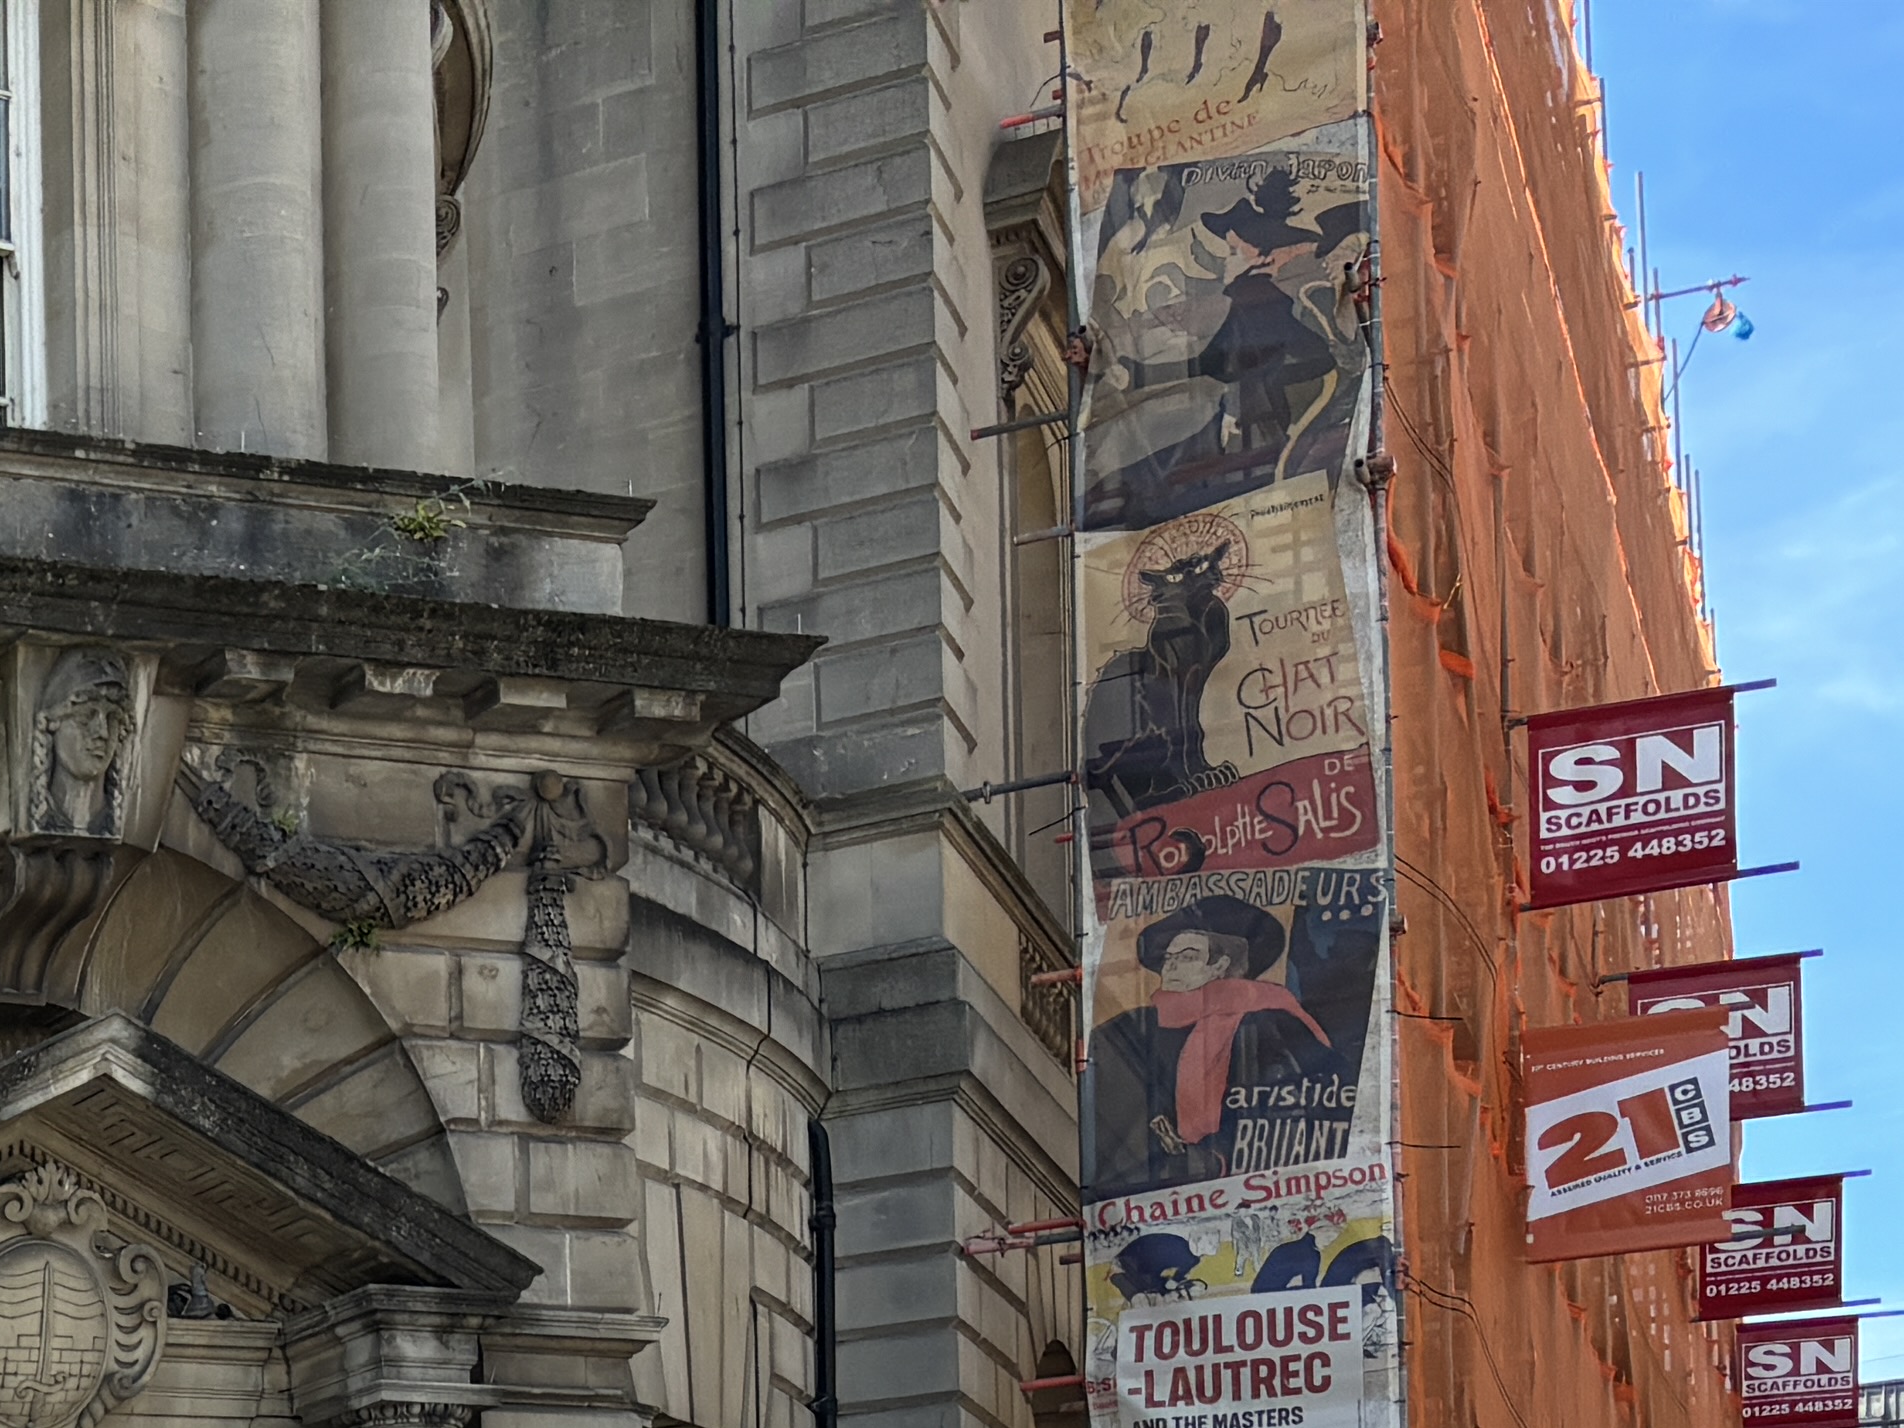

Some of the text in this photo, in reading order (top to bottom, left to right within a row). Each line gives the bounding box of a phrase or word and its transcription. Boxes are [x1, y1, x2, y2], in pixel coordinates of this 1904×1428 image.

[1193, 98, 1231, 125] de
[1236, 652, 1340, 715] CHAT
[1244, 695, 1366, 758] NOIR
[1324, 754, 1357, 776] DE
[1546, 725, 1721, 806] SN
[1545, 788, 1721, 834] SCAFFOLDS
[1540, 828, 1726, 875] 01225 448352
[1225, 1073, 1358, 1109] aristide
[1230, 1117, 1350, 1176] BRUANT
[1537, 1087, 1681, 1190] 21
[1097, 1161, 1387, 1230] Chaîne Simpson
[1709, 1245, 1832, 1270] SCAFFOLDS
[1706, 1281, 1761, 1297] 01225
[1766, 1273, 1835, 1291] 448352
[1128, 1300, 1352, 1363] TOULOUSE
[1127, 1351, 1332, 1409] -LAUTREC
[1746, 1338, 1851, 1379] SN
[1745, 1375, 1851, 1395] SCAFFOLDS
[1742, 1403, 1790, 1418] 01225
